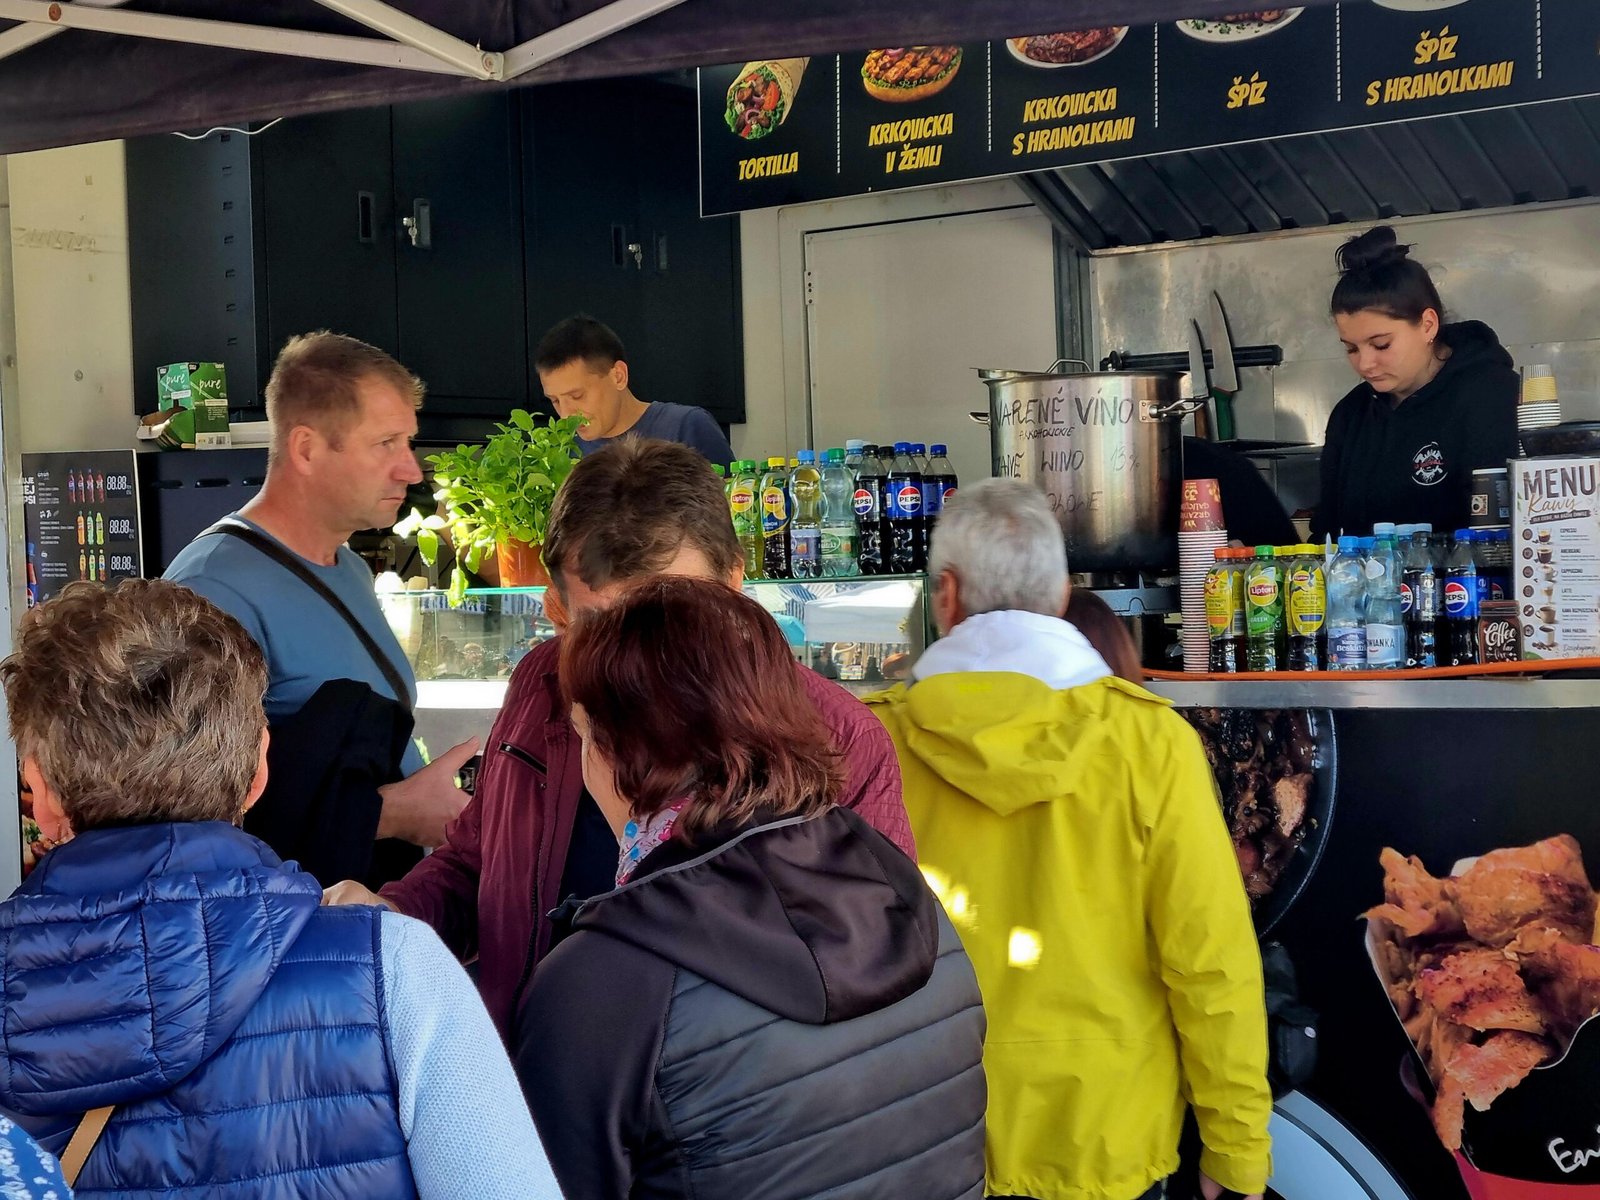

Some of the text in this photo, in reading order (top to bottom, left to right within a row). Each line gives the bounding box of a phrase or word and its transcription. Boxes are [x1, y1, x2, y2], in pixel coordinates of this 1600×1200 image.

[1414, 25, 1460, 65] ŠPÍZ
[1227, 70, 1268, 109] ŠPÍZ
[1365, 61, 1515, 106] S HRANOLKAMI
[1023, 87, 1117, 123] KRKOVICKA
[868, 113, 954, 146] KRKOVICKA
[1012, 117, 1135, 156] S HRANOLKAMI
[738, 151, 799, 181] TORTILLA
[885, 144, 942, 173] V ŽEMLI
[165, 373, 185, 391] pure
[199, 380, 221, 396] pure
[1075, 388, 1134, 426] VÍNO
[1040, 449, 1085, 472] WINO
[1523, 465, 1596, 500] MENU
[1528, 494, 1575, 516] Kawy
[1250, 587, 1275, 595] Lipton
[1484, 621, 1517, 647] Coffee
